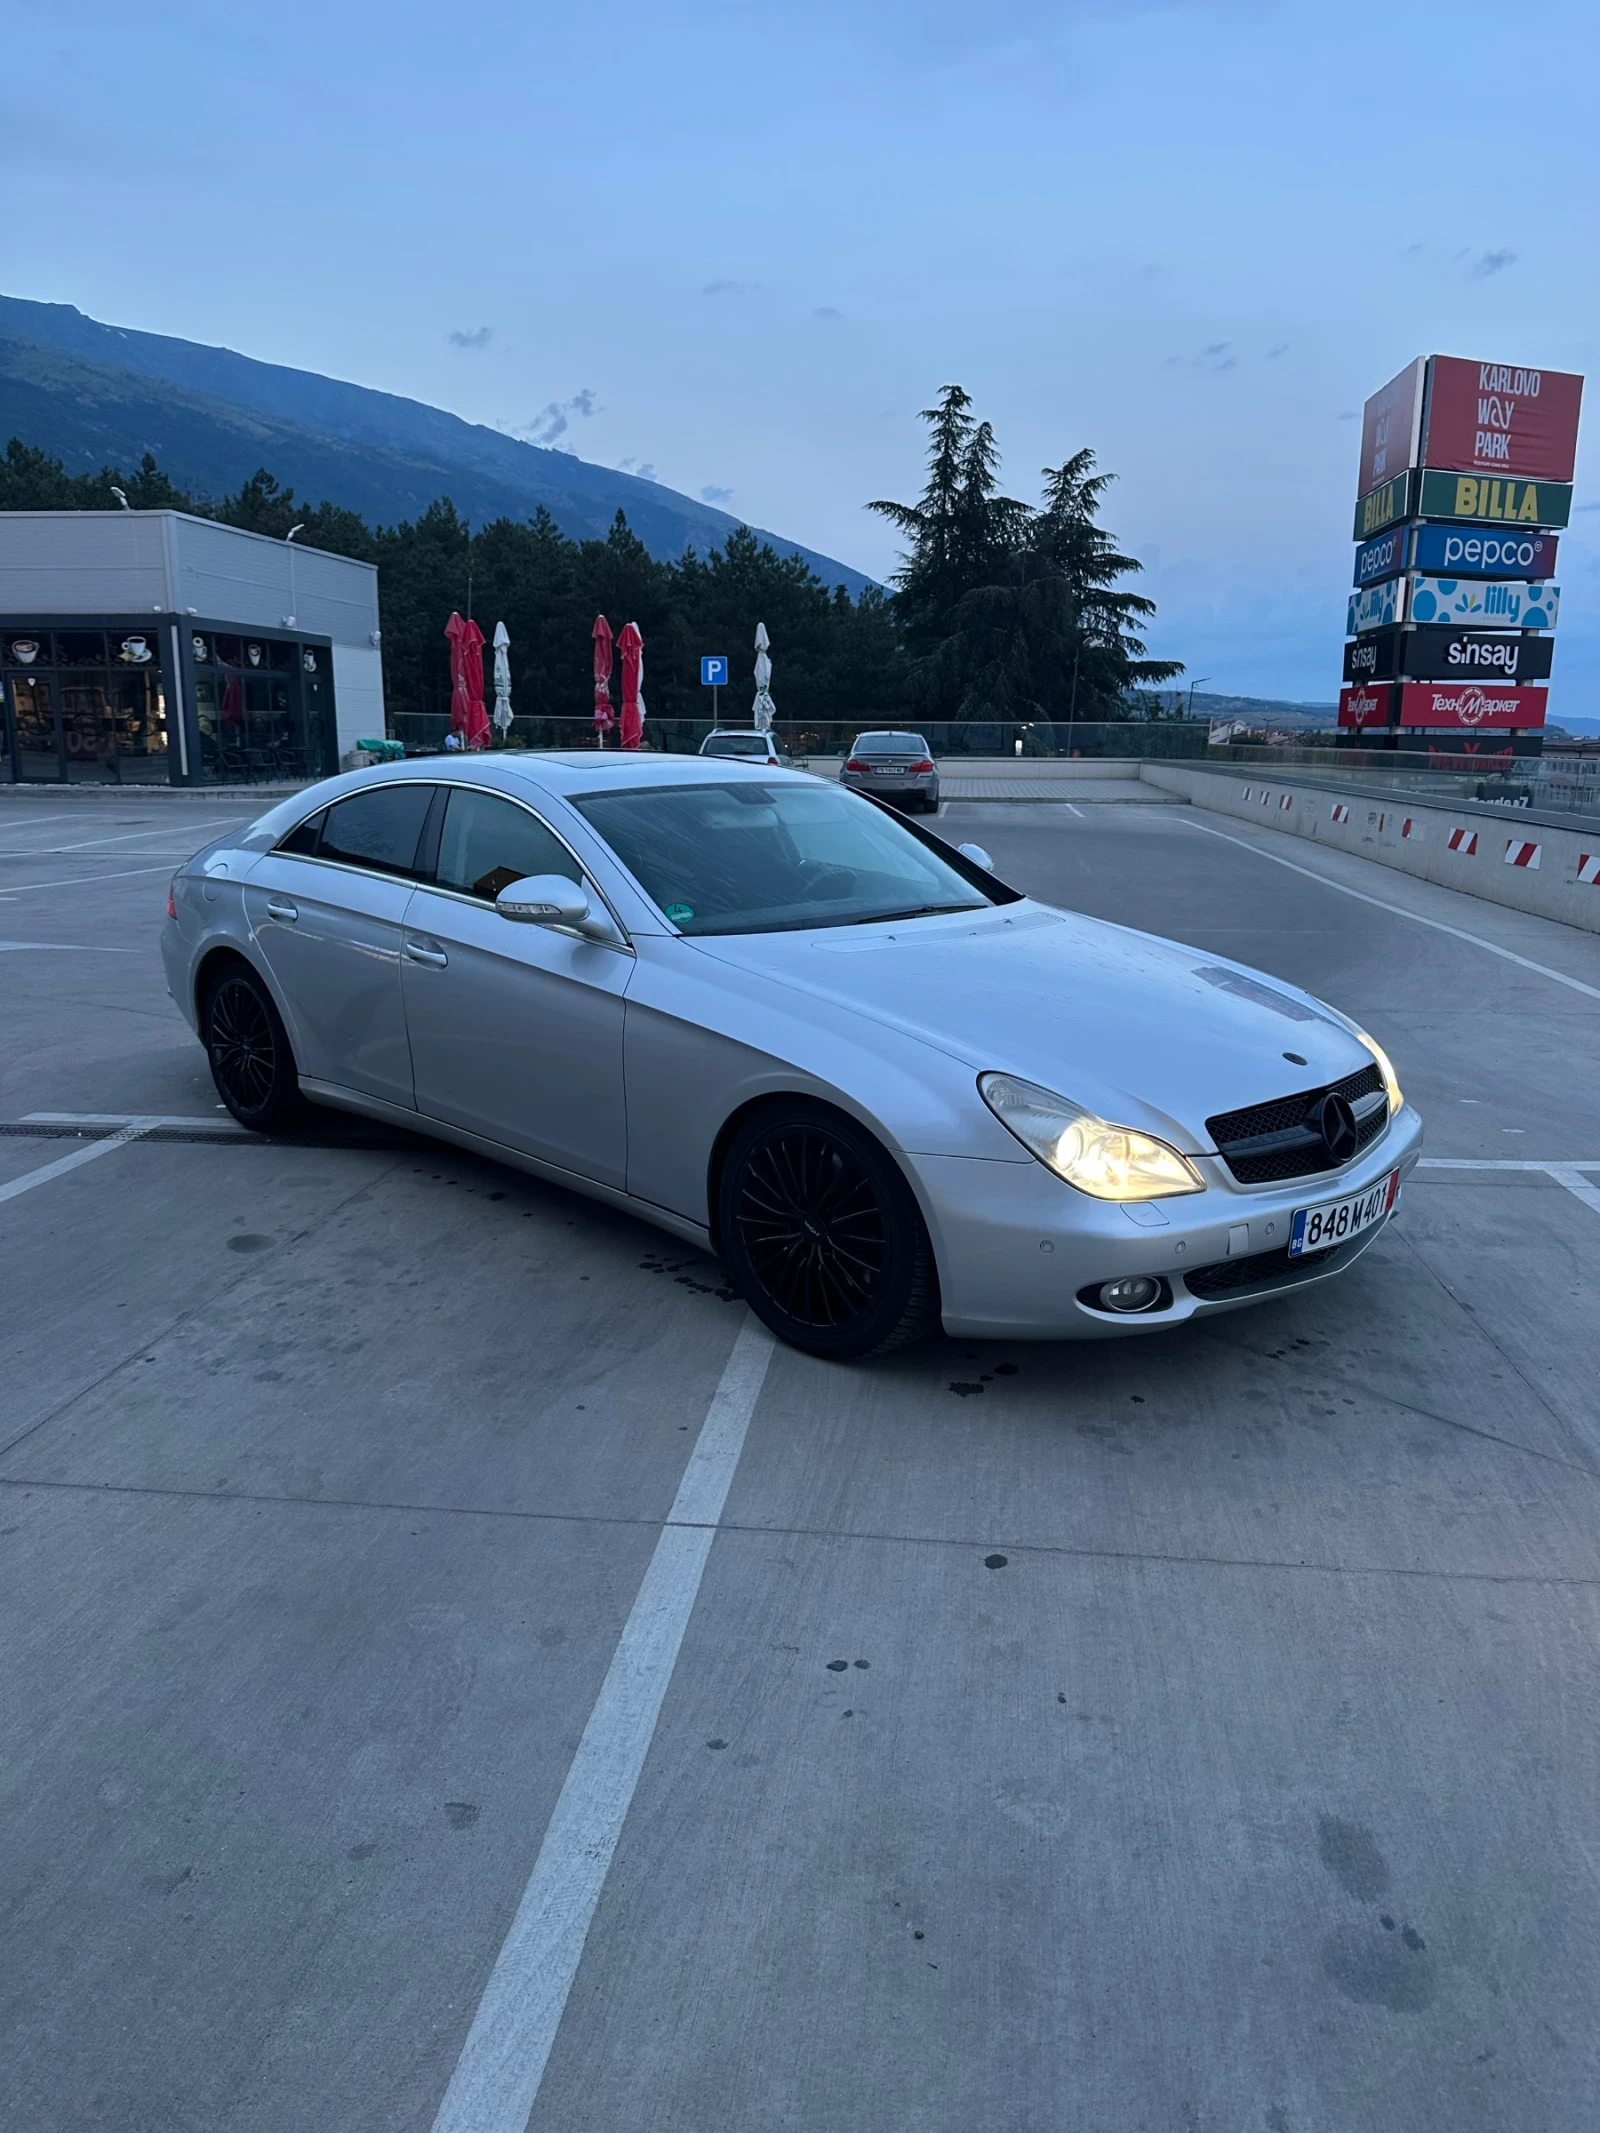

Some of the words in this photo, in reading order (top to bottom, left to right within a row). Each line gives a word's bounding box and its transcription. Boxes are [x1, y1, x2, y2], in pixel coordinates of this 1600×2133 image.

[1478, 364, 1541, 398] KARLOVO
[1474, 431, 1512, 460] PARK
[1363, 484, 1394, 533] BILLA
[1454, 477, 1538, 522] BILLA
[1484, 585, 1521, 624] lilly
[708, 660, 722, 681] P
[1351, 643, 1377, 674] sinsay
[1447, 636, 1519, 675] sinsay
[1292, 1238, 1303, 1249] BG
